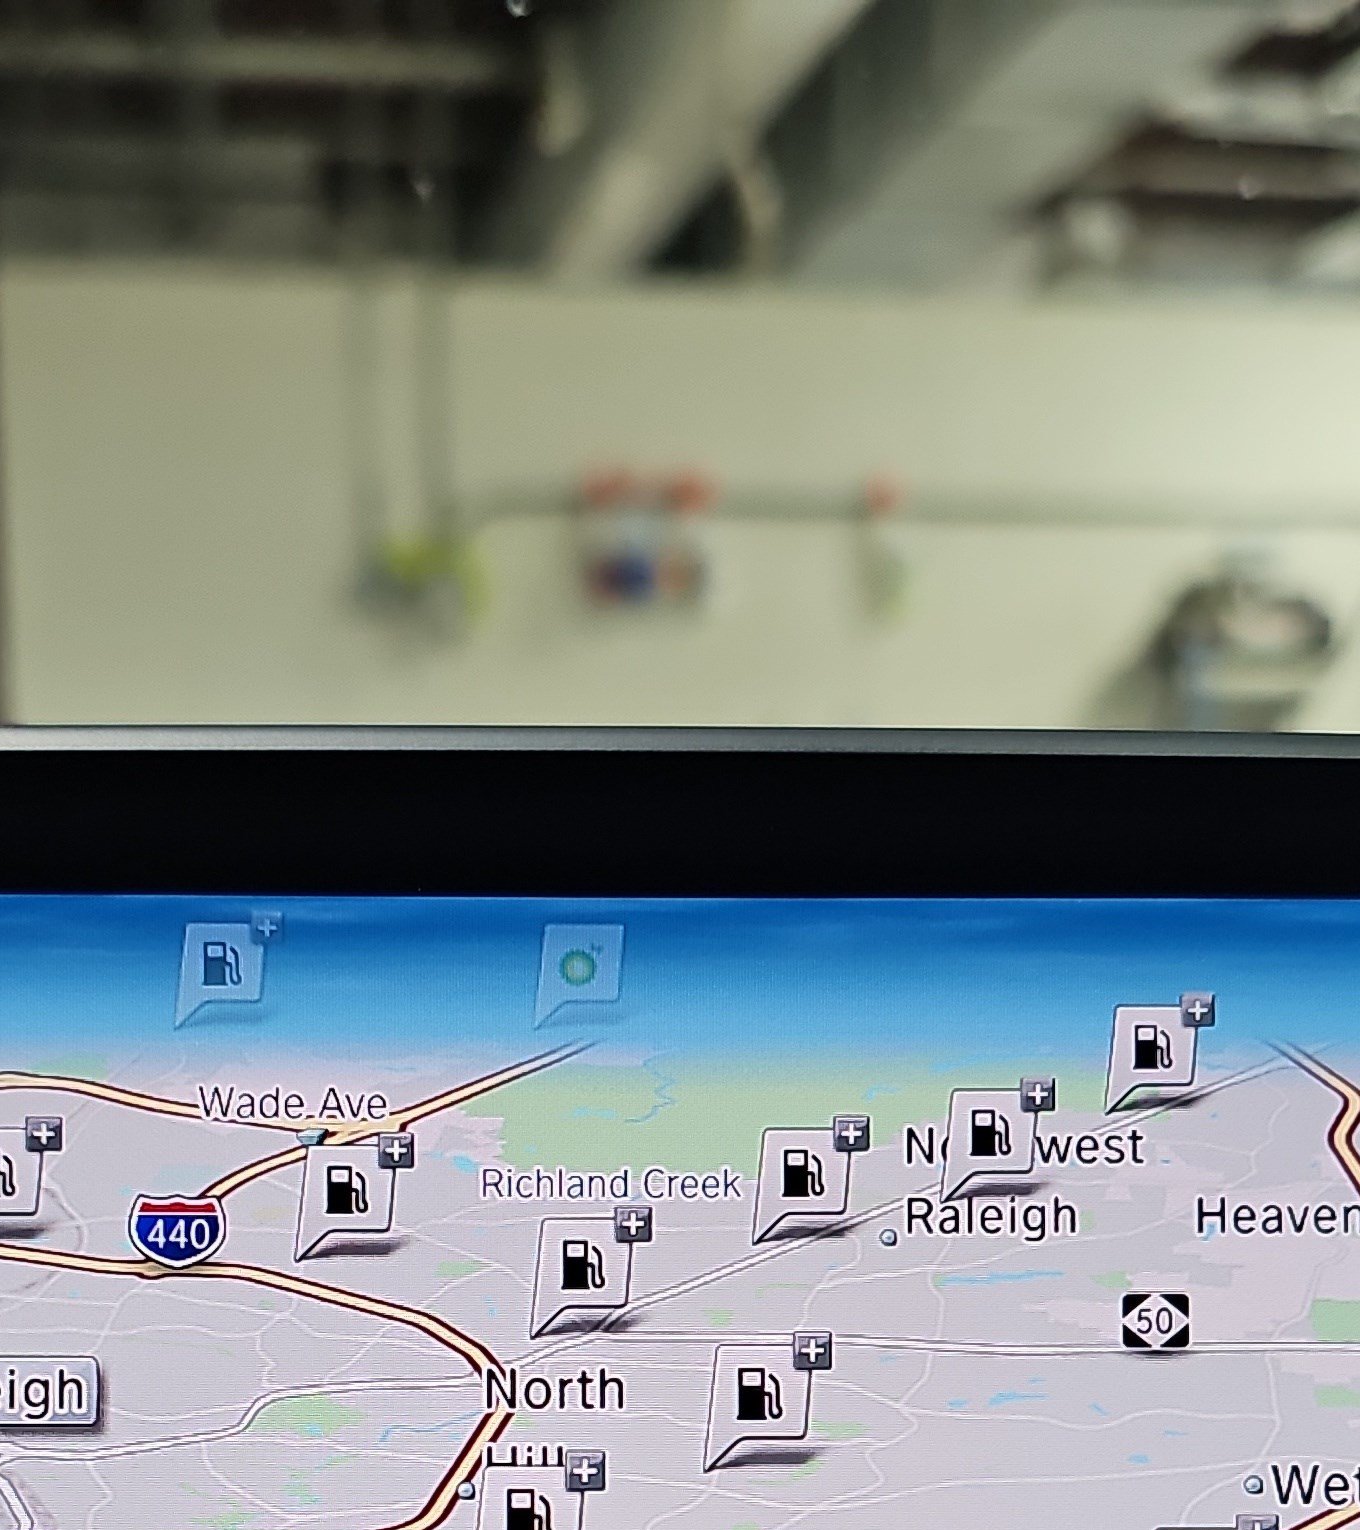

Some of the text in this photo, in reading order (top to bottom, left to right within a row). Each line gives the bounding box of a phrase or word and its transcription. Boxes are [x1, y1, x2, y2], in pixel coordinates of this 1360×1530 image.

[199, 1087, 388, 1119] Wade Ave
[481, 1168, 741, 1199] Richland Creek
[147, 1219, 210, 1250] 440
[906, 1198, 1077, 1240] Raleigh
[1137, 1309, 1174, 1334] 50
[486, 1370, 626, 1410] North
